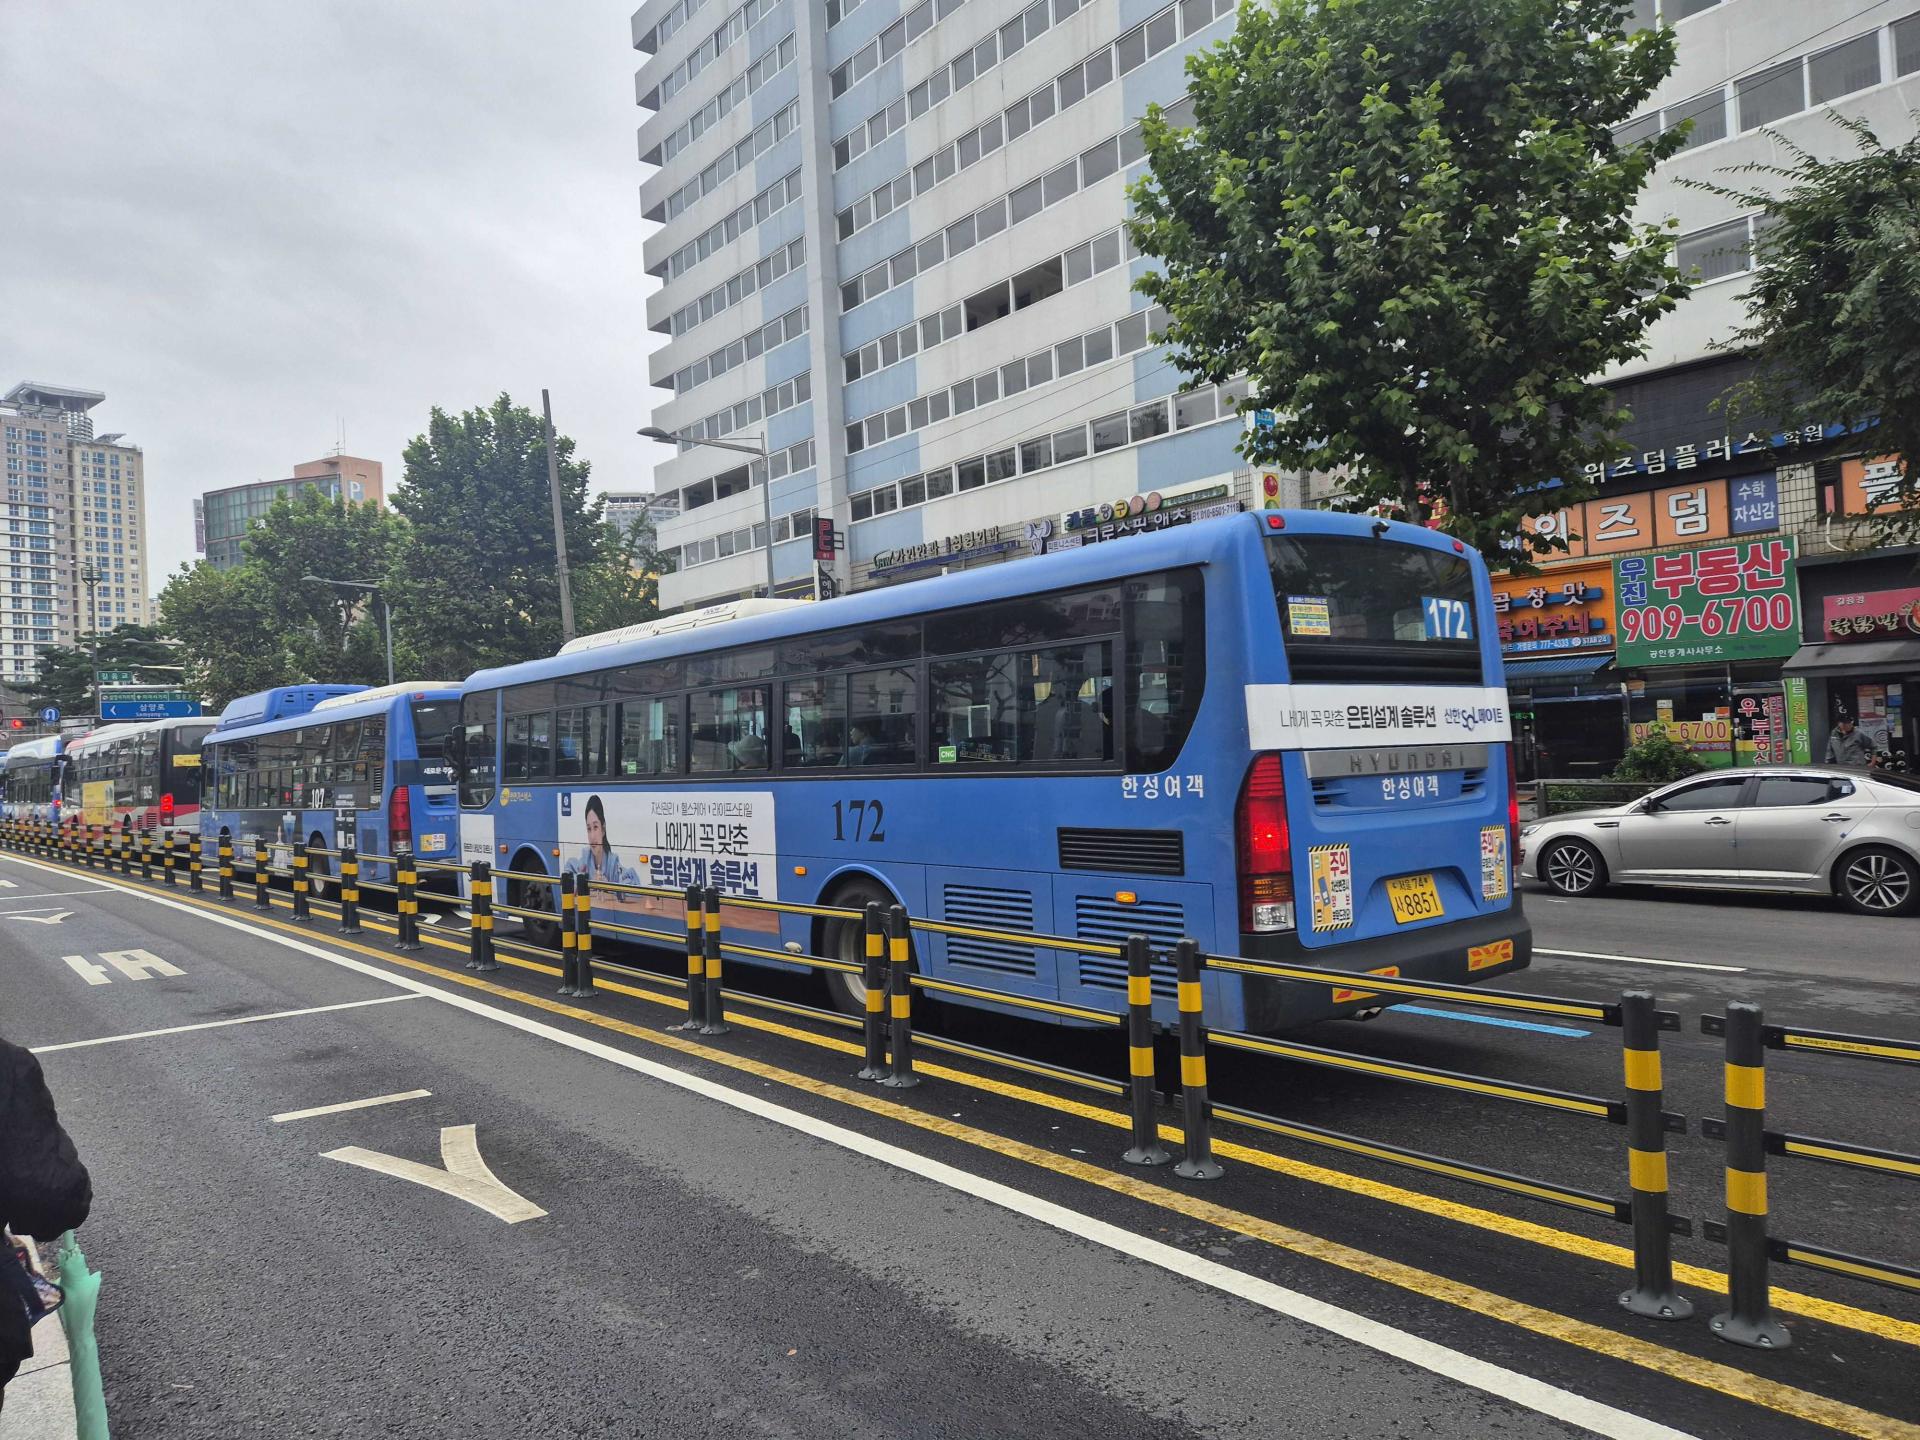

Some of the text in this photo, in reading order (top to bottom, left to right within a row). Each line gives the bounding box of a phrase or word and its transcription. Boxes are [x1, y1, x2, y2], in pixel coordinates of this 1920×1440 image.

[1738, 480, 1766, 499] 수학
[1734, 503, 1775, 524] 자신감
[1619, 558, 1647, 606] 우진
[1652, 540, 1791, 599] 부동산
[1428, 598, 1468, 639] 172
[1621, 593, 1793, 643] 909-6700
[1346, 705, 1399, 730] 은퇴설계
[1401, 705, 1437, 729] 솔루션
[1121, 774, 1204, 799] 한성여객
[1381, 775, 1439, 801] 한성여객
[656, 821, 749, 857] 나에게 꼭 맞춘
[831, 799, 886, 843] 172
[650, 854, 759, 897] 은퇴설계 솔루션
[1329, 850, 1349, 877] 주의
